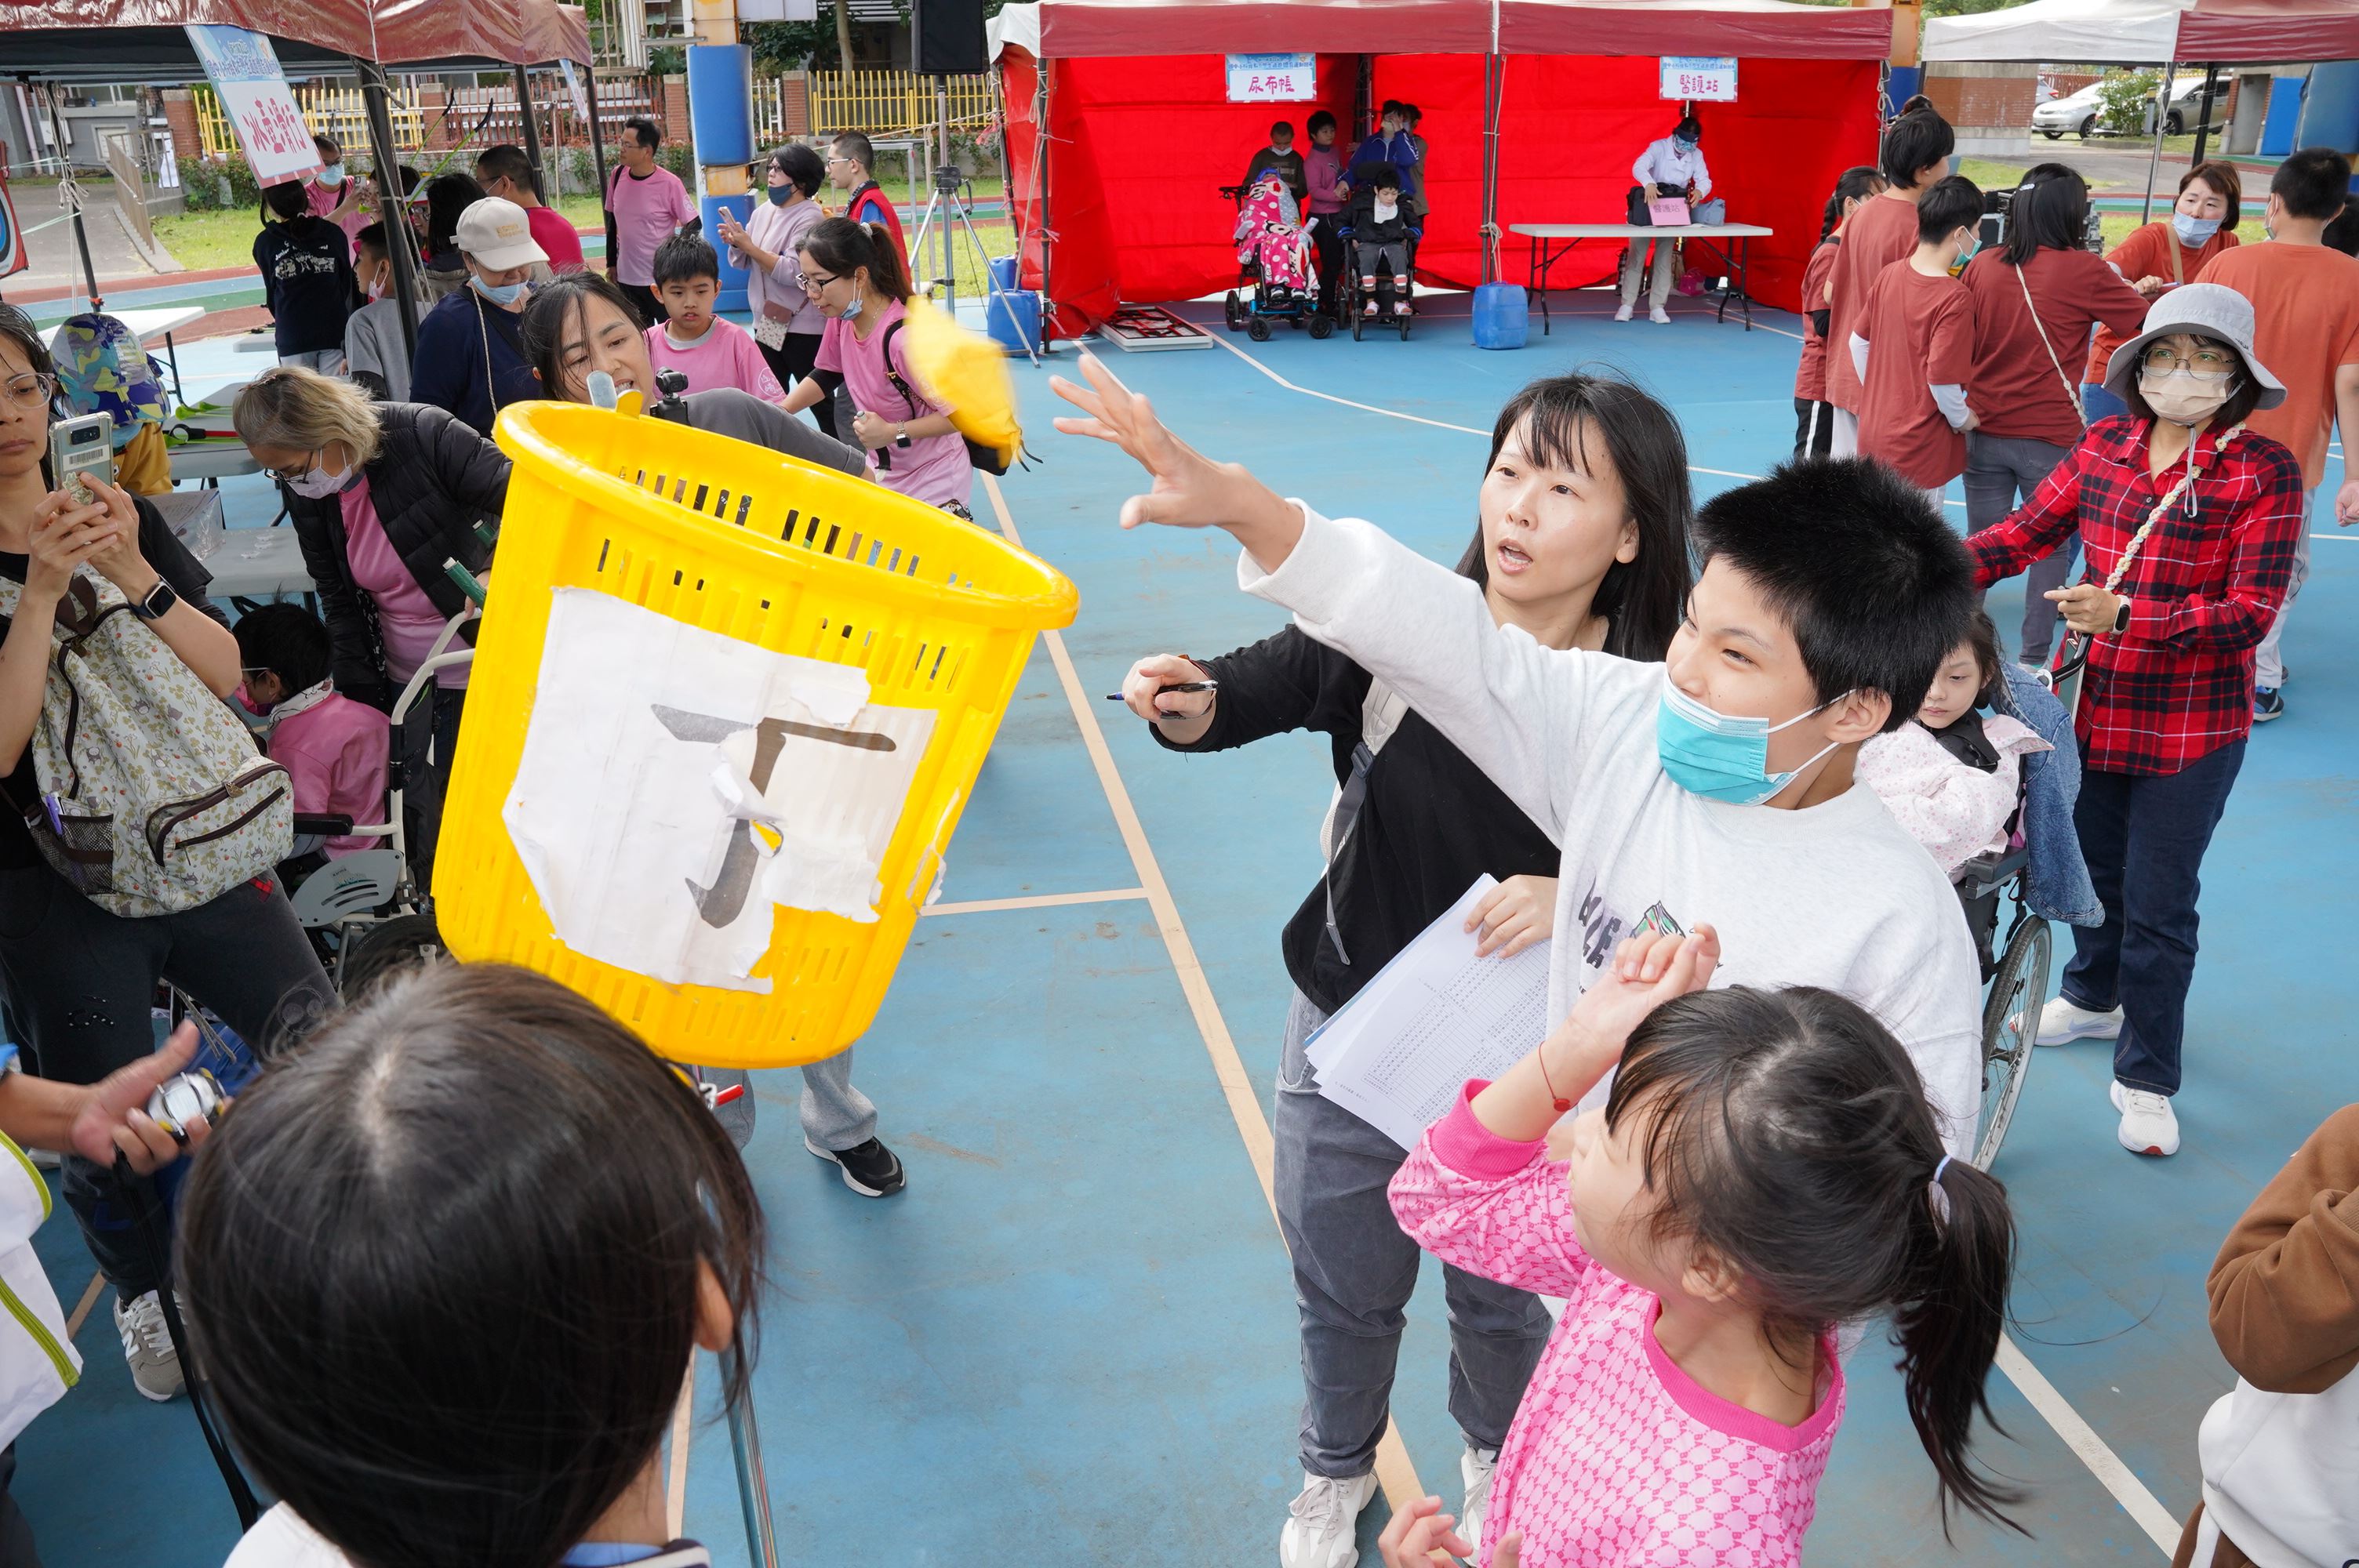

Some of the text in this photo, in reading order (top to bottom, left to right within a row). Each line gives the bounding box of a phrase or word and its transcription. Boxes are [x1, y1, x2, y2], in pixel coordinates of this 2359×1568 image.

[1249, 75, 1295, 95] 尿布帳
[1680, 74, 1718, 94] 醫護站
